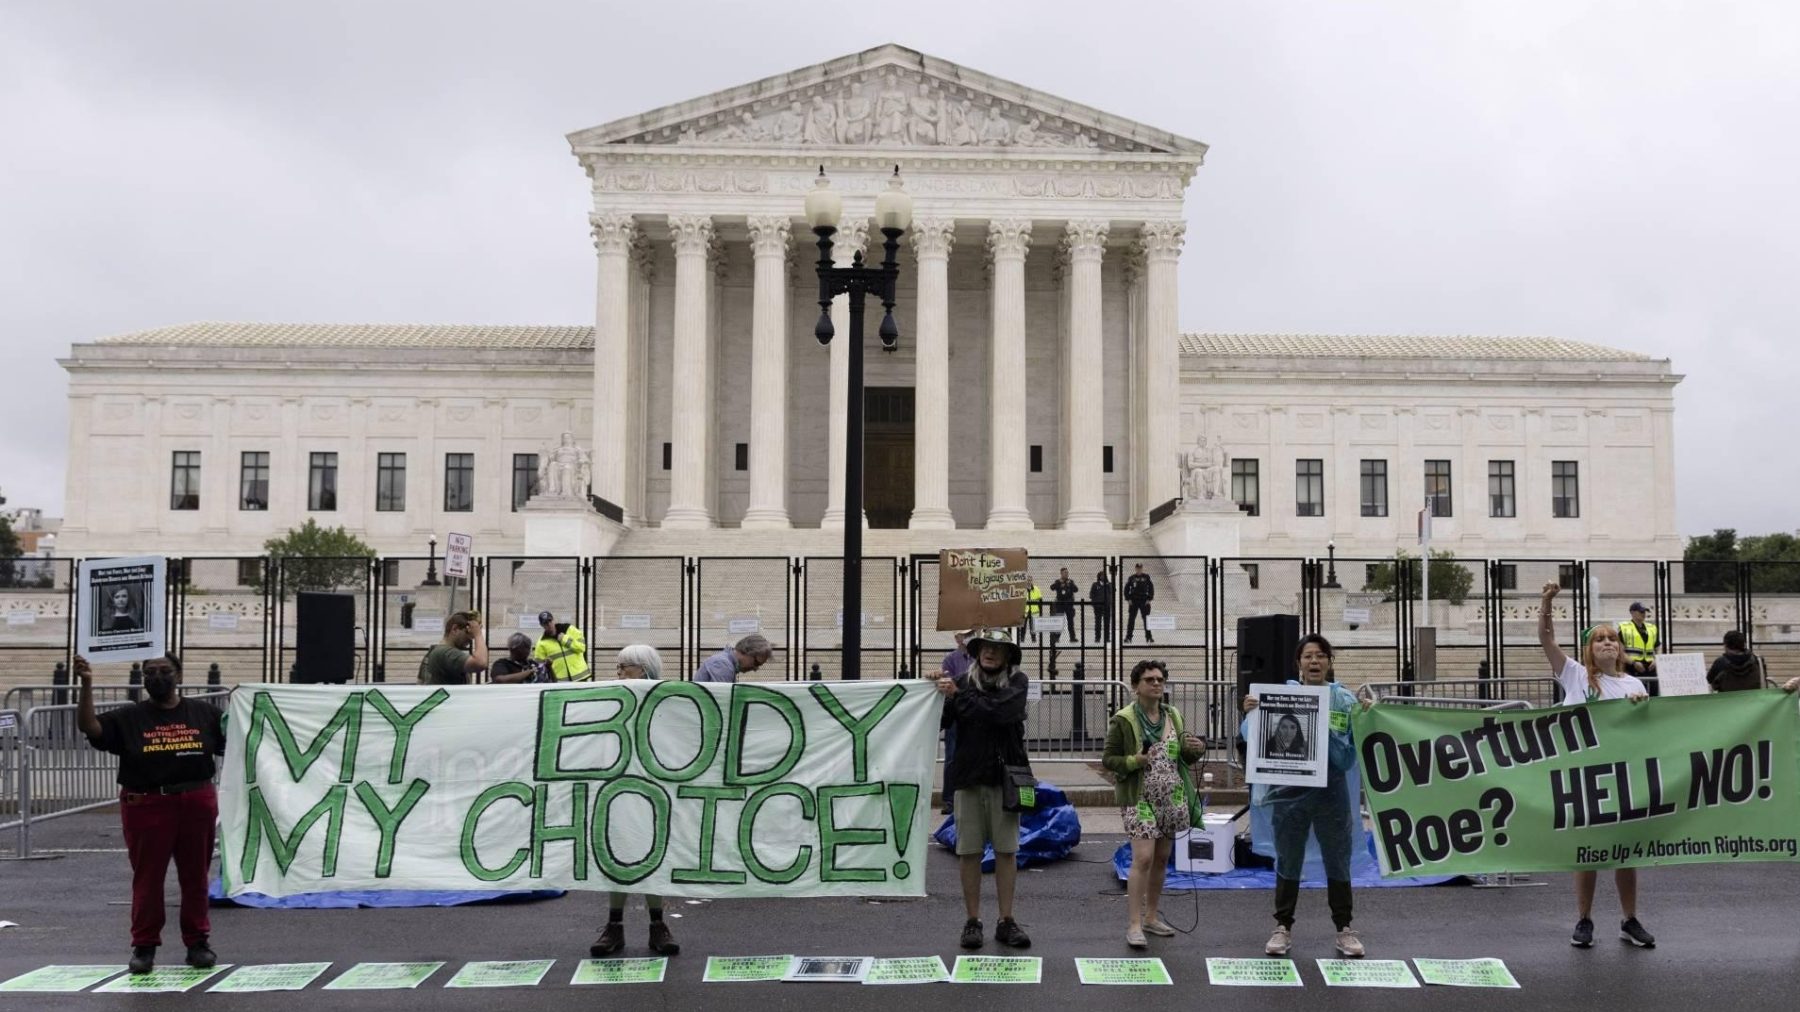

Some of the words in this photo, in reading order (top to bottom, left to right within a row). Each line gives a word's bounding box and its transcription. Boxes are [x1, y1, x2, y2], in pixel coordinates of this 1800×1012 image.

[450, 544, 469, 554] PARKING
[455, 537, 465, 545] NO
[979, 553, 1001, 568] fuse
[143, 729, 200, 738] MOTHERHOOD
[162, 735, 194, 743] FEMALE
[246, 687, 450, 784] MY
[532, 680, 907, 786] BODY
[143, 742, 204, 753] ENSLAVEMENT
[1361, 706, 1600, 796] Overturn
[1550, 757, 1677, 830] HELL
[1687, 740, 1773, 810] NO!
[241, 778, 431, 883] MY
[460, 775, 920, 885] CHOICE!
[1377, 787, 1515, 873] Roe?
[1576, 846, 1608, 864] Rise
[1612, 844, 1630, 863] Up
[1632, 842, 1643, 858] 4
[1646, 837, 1712, 858] Abortion
[1714, 835, 1798, 858] Rights.org
